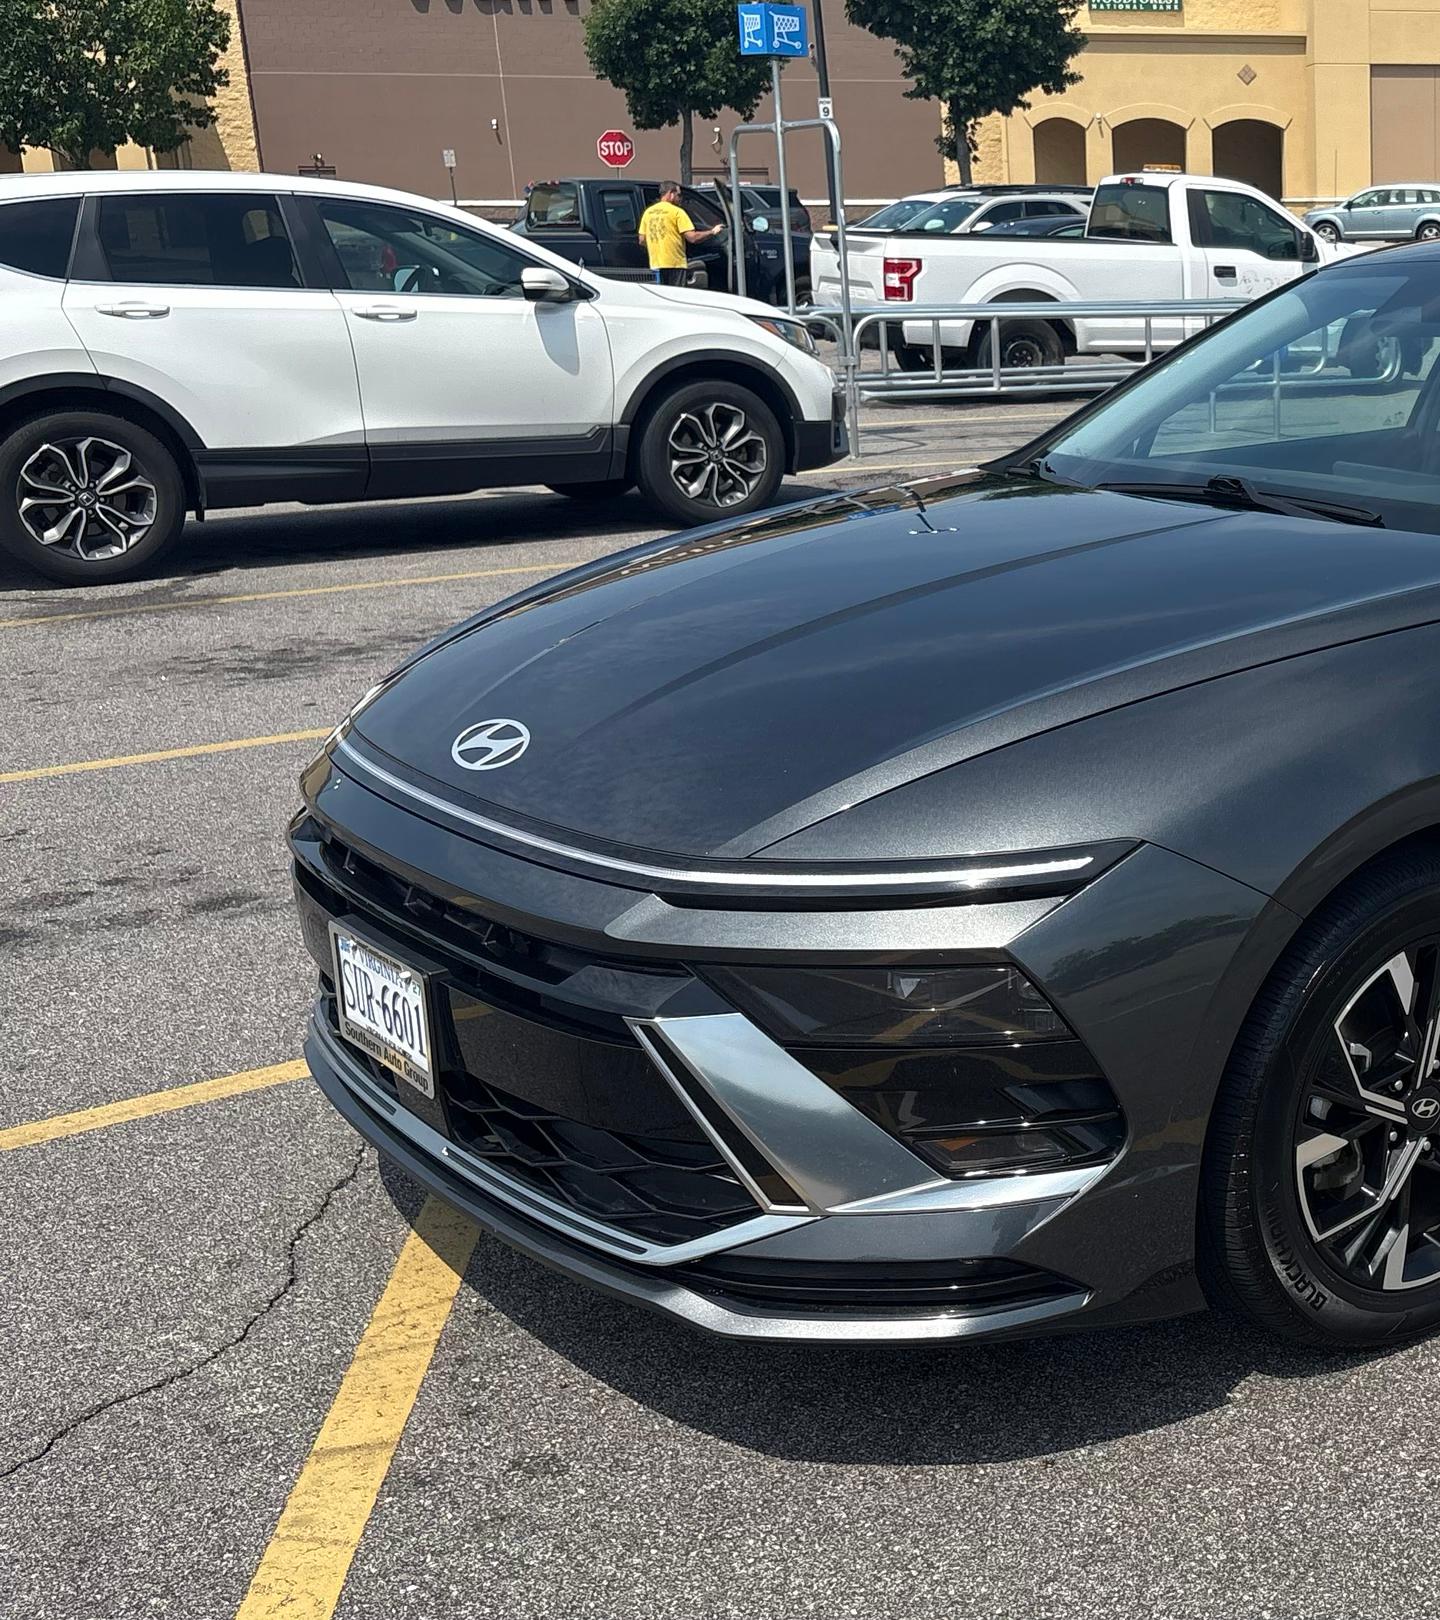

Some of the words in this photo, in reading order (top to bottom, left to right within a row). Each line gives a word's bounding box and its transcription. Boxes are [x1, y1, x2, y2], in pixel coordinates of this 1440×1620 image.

[823, 106, 829, 117] 9
[601, 141, 631, 156] STOP
[343, 959, 427, 1058] SUR-6601
[345, 1021, 382, 1057] Southern
[384, 1047, 402, 1071] Auto
[404, 1061, 428, 1092] Group
